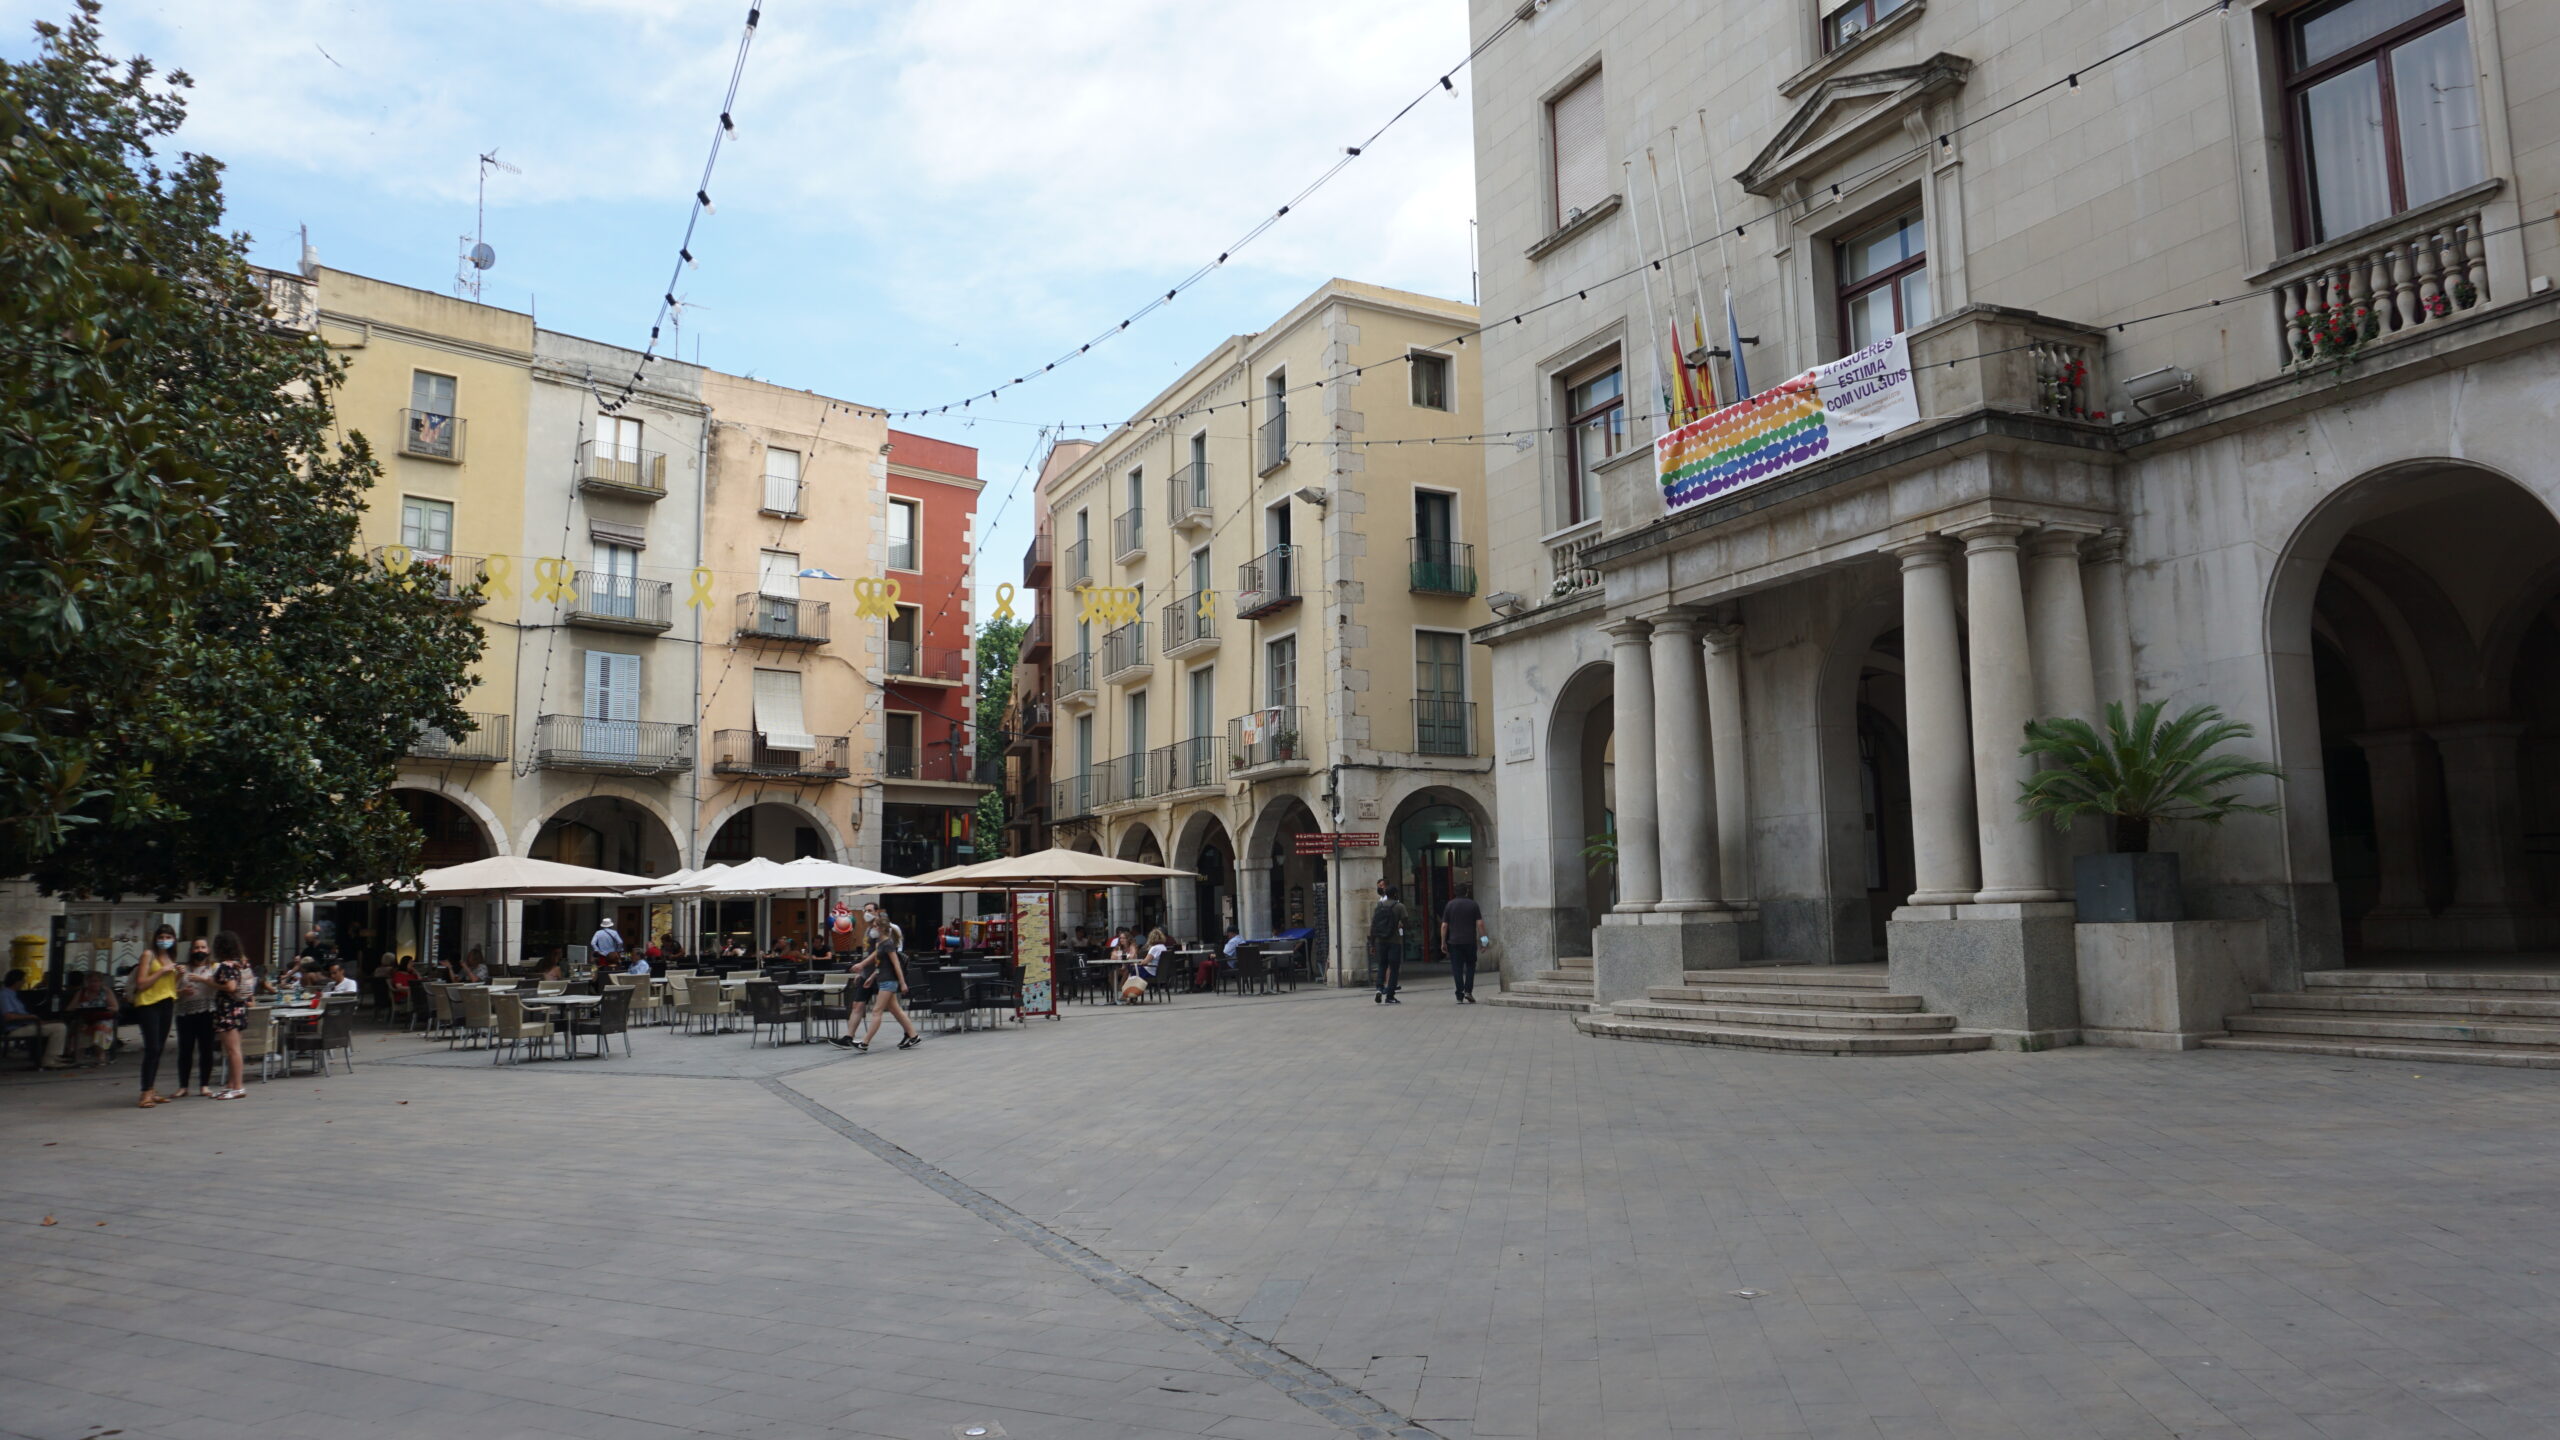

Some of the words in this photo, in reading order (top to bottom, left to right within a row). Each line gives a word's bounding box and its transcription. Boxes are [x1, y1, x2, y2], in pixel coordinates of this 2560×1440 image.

[1827, 391, 1854, 412] COM
[1853, 368, 1908, 400] VULGUIS
[1838, 358, 1887, 389] ESTIMA
